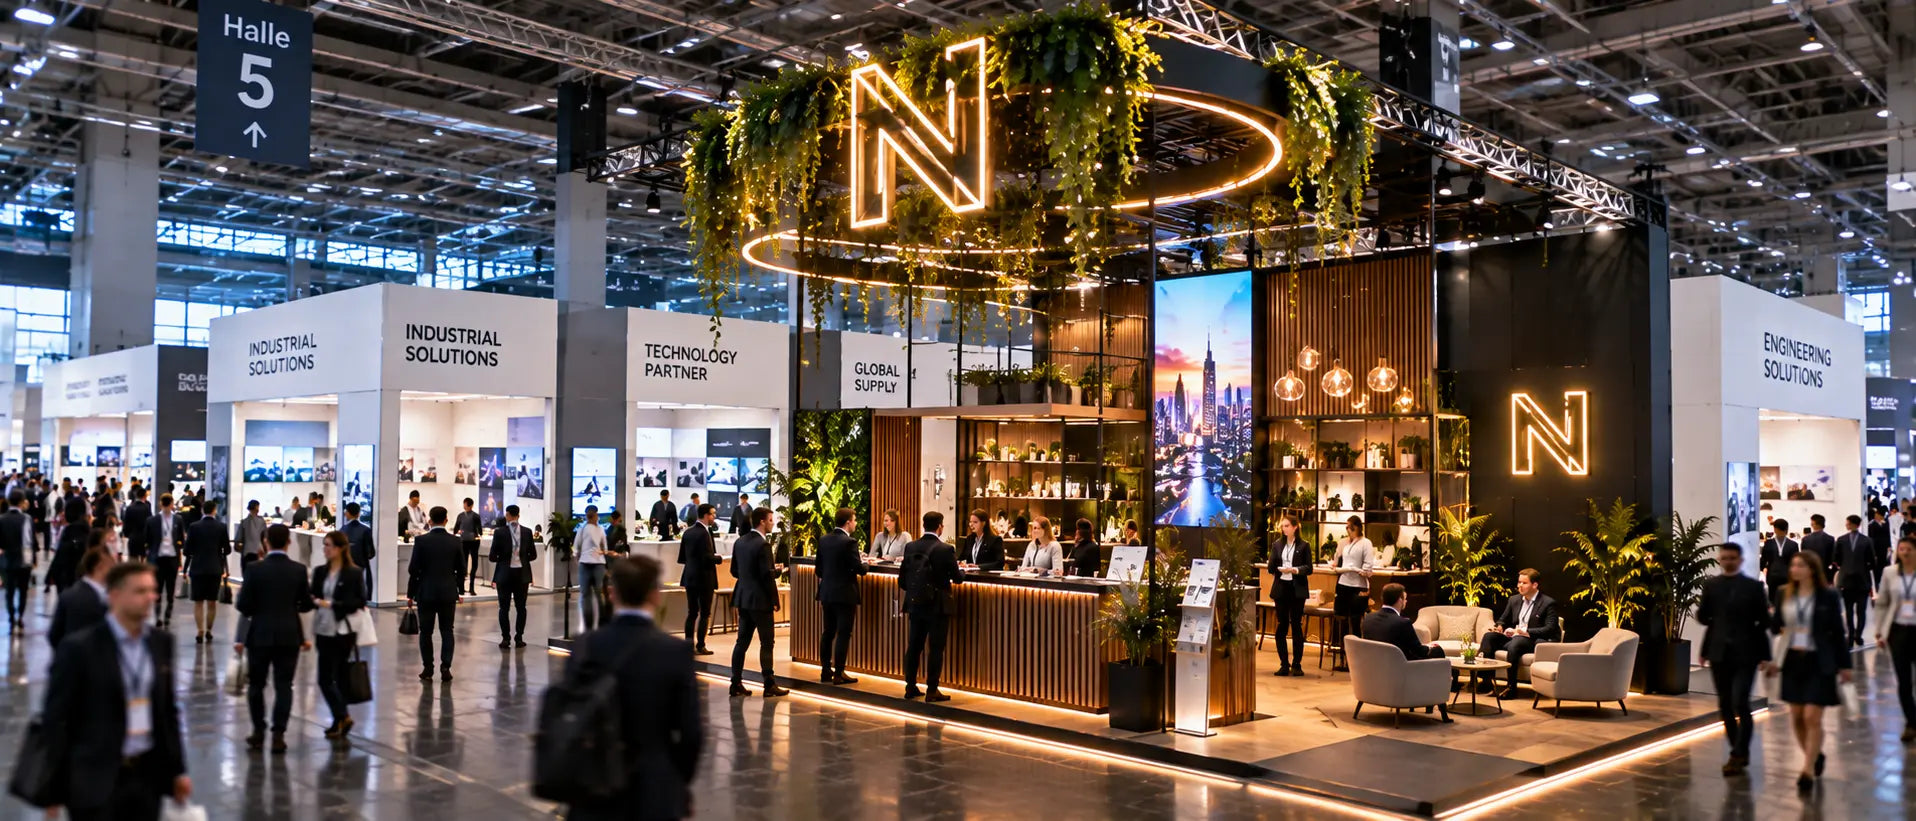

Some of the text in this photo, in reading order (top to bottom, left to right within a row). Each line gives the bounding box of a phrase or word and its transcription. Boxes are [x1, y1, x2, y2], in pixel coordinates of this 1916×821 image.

[224, 13, 290, 48] Halle
[237, 53, 274, 109] 5
[851, 37, 986, 228] N
[249, 333, 317, 357] INDUSTRIAL
[406, 323, 502, 346] INDUSTRIAL
[406, 346, 499, 367] SOLUTIONS
[645, 343, 738, 365] TECHNOLOGY
[1764, 331, 1832, 367] ENGINEERING
[249, 354, 315, 377] SOLUTIONS
[645, 363, 708, 381] PARTNER
[855, 361, 900, 378] GLOBAL
[1764, 358, 1824, 388] SOLUTIONS
[855, 379, 898, 393] SUPPLY
[1512, 391, 1588, 475] N
